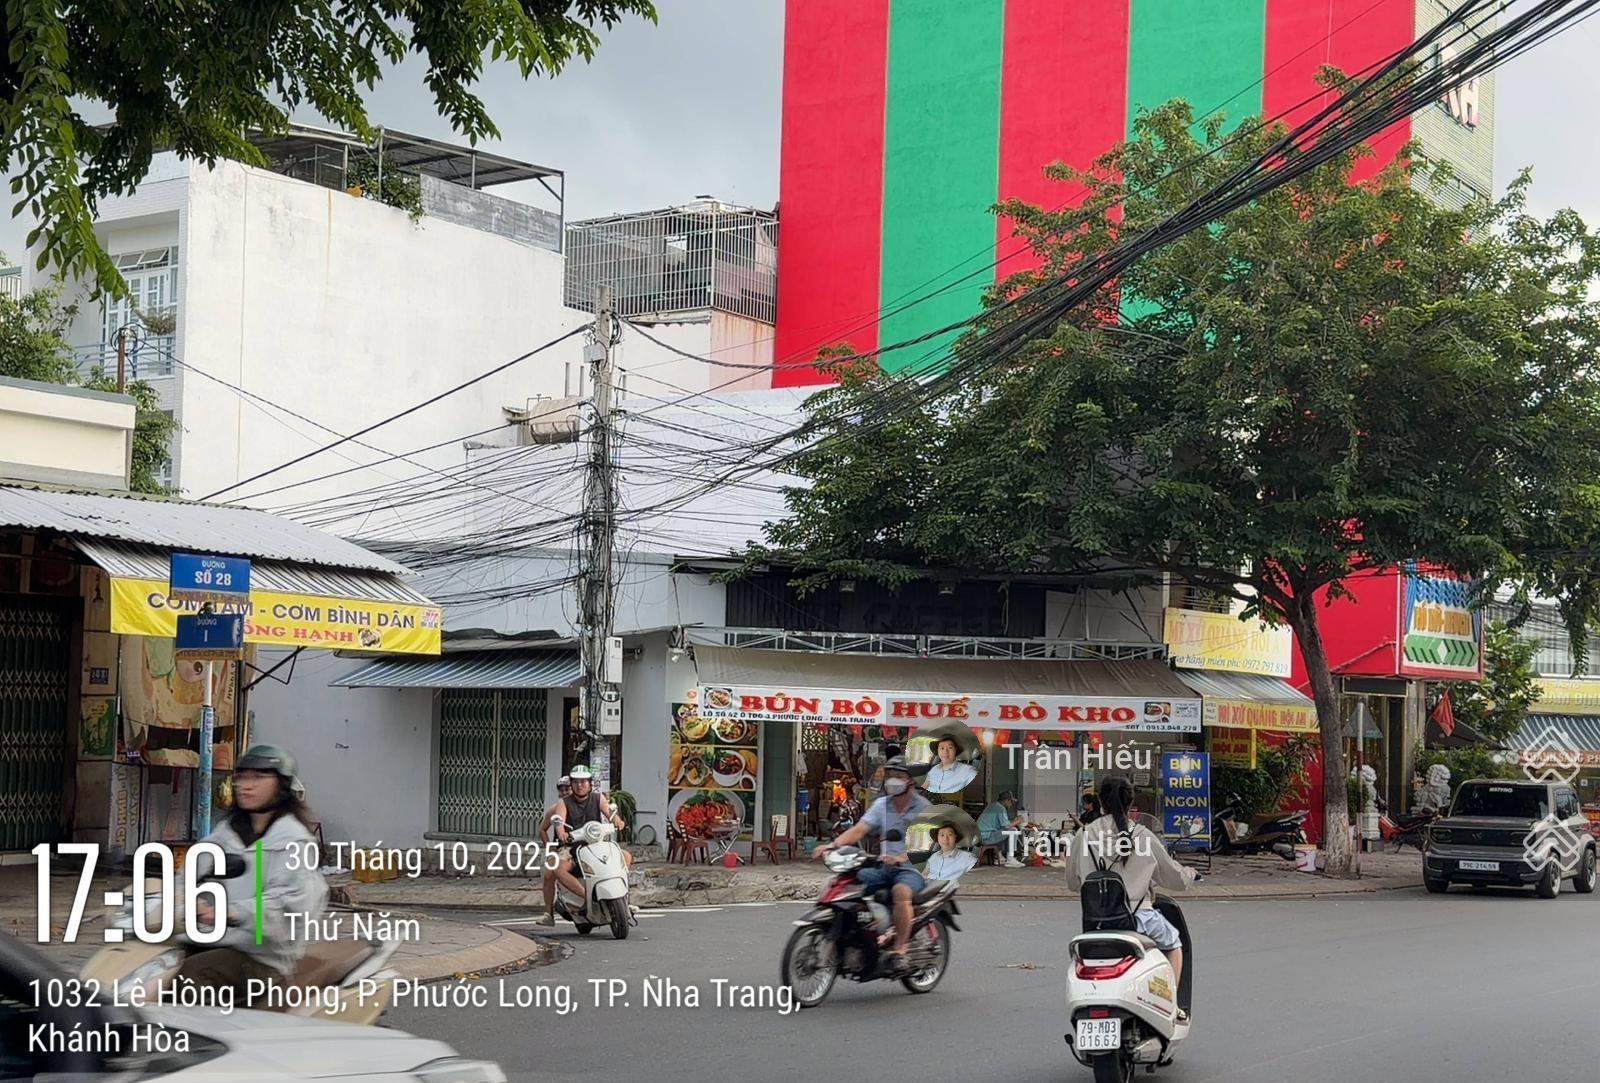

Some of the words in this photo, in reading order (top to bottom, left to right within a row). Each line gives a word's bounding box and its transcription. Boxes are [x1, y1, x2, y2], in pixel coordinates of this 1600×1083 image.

[194, 568, 212, 585] SỐ
[215, 572, 232, 586] 28
[272, 603, 321, 622] CƠM
[327, 605, 371, 626] BÌNH
[377, 610, 415, 629] DÂN
[293, 628, 354, 643] HẠNH
[740, 692, 821, 715] BÚN
[830, 695, 882, 717] BÒ
[891, 696, 971, 720] HUẾ
[999, 701, 1049, 721] BÒ
[1057, 705, 1136, 723] KHO
[1169, 774, 1202, 789] RIÊU
[1165, 796, 1208, 807] NGON
[1080, 1034, 1118, 1048] 016.62
